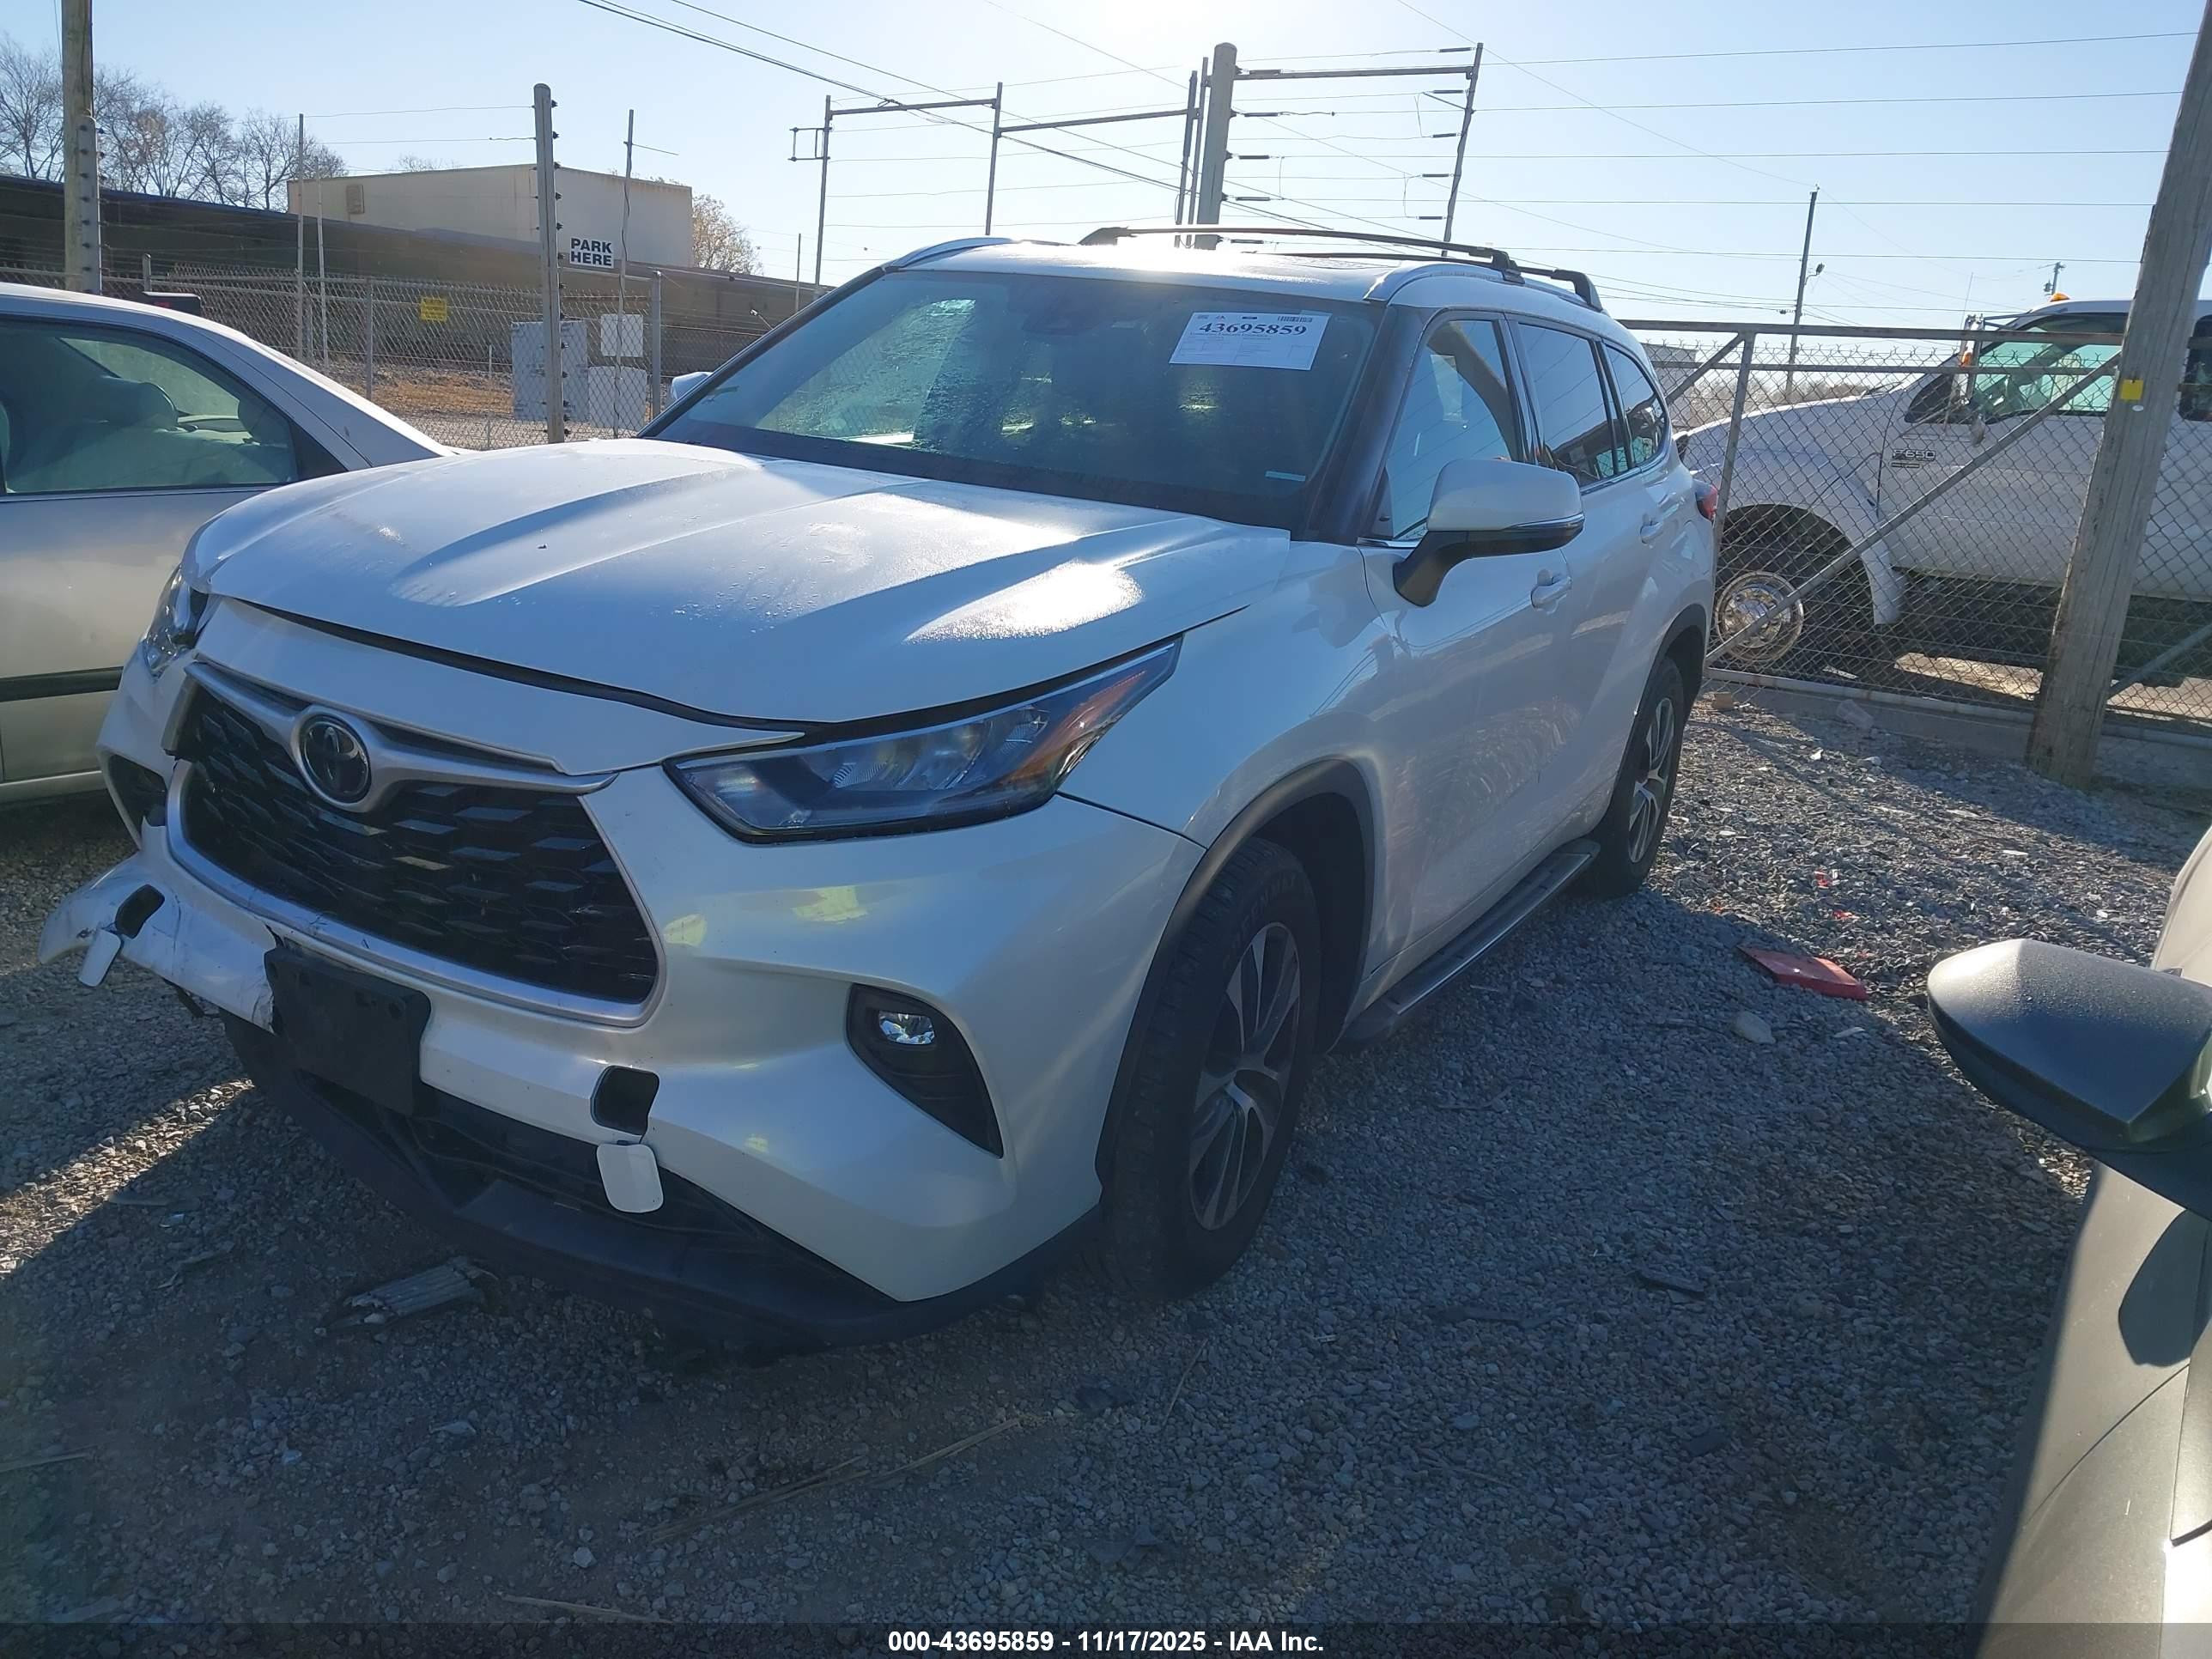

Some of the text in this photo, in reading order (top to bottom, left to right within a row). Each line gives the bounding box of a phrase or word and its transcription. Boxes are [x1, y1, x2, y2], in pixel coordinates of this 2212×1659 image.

[570, 237, 612, 253] PARK
[570, 251, 612, 266] HERE
[1199, 322, 1307, 336] 43695859
